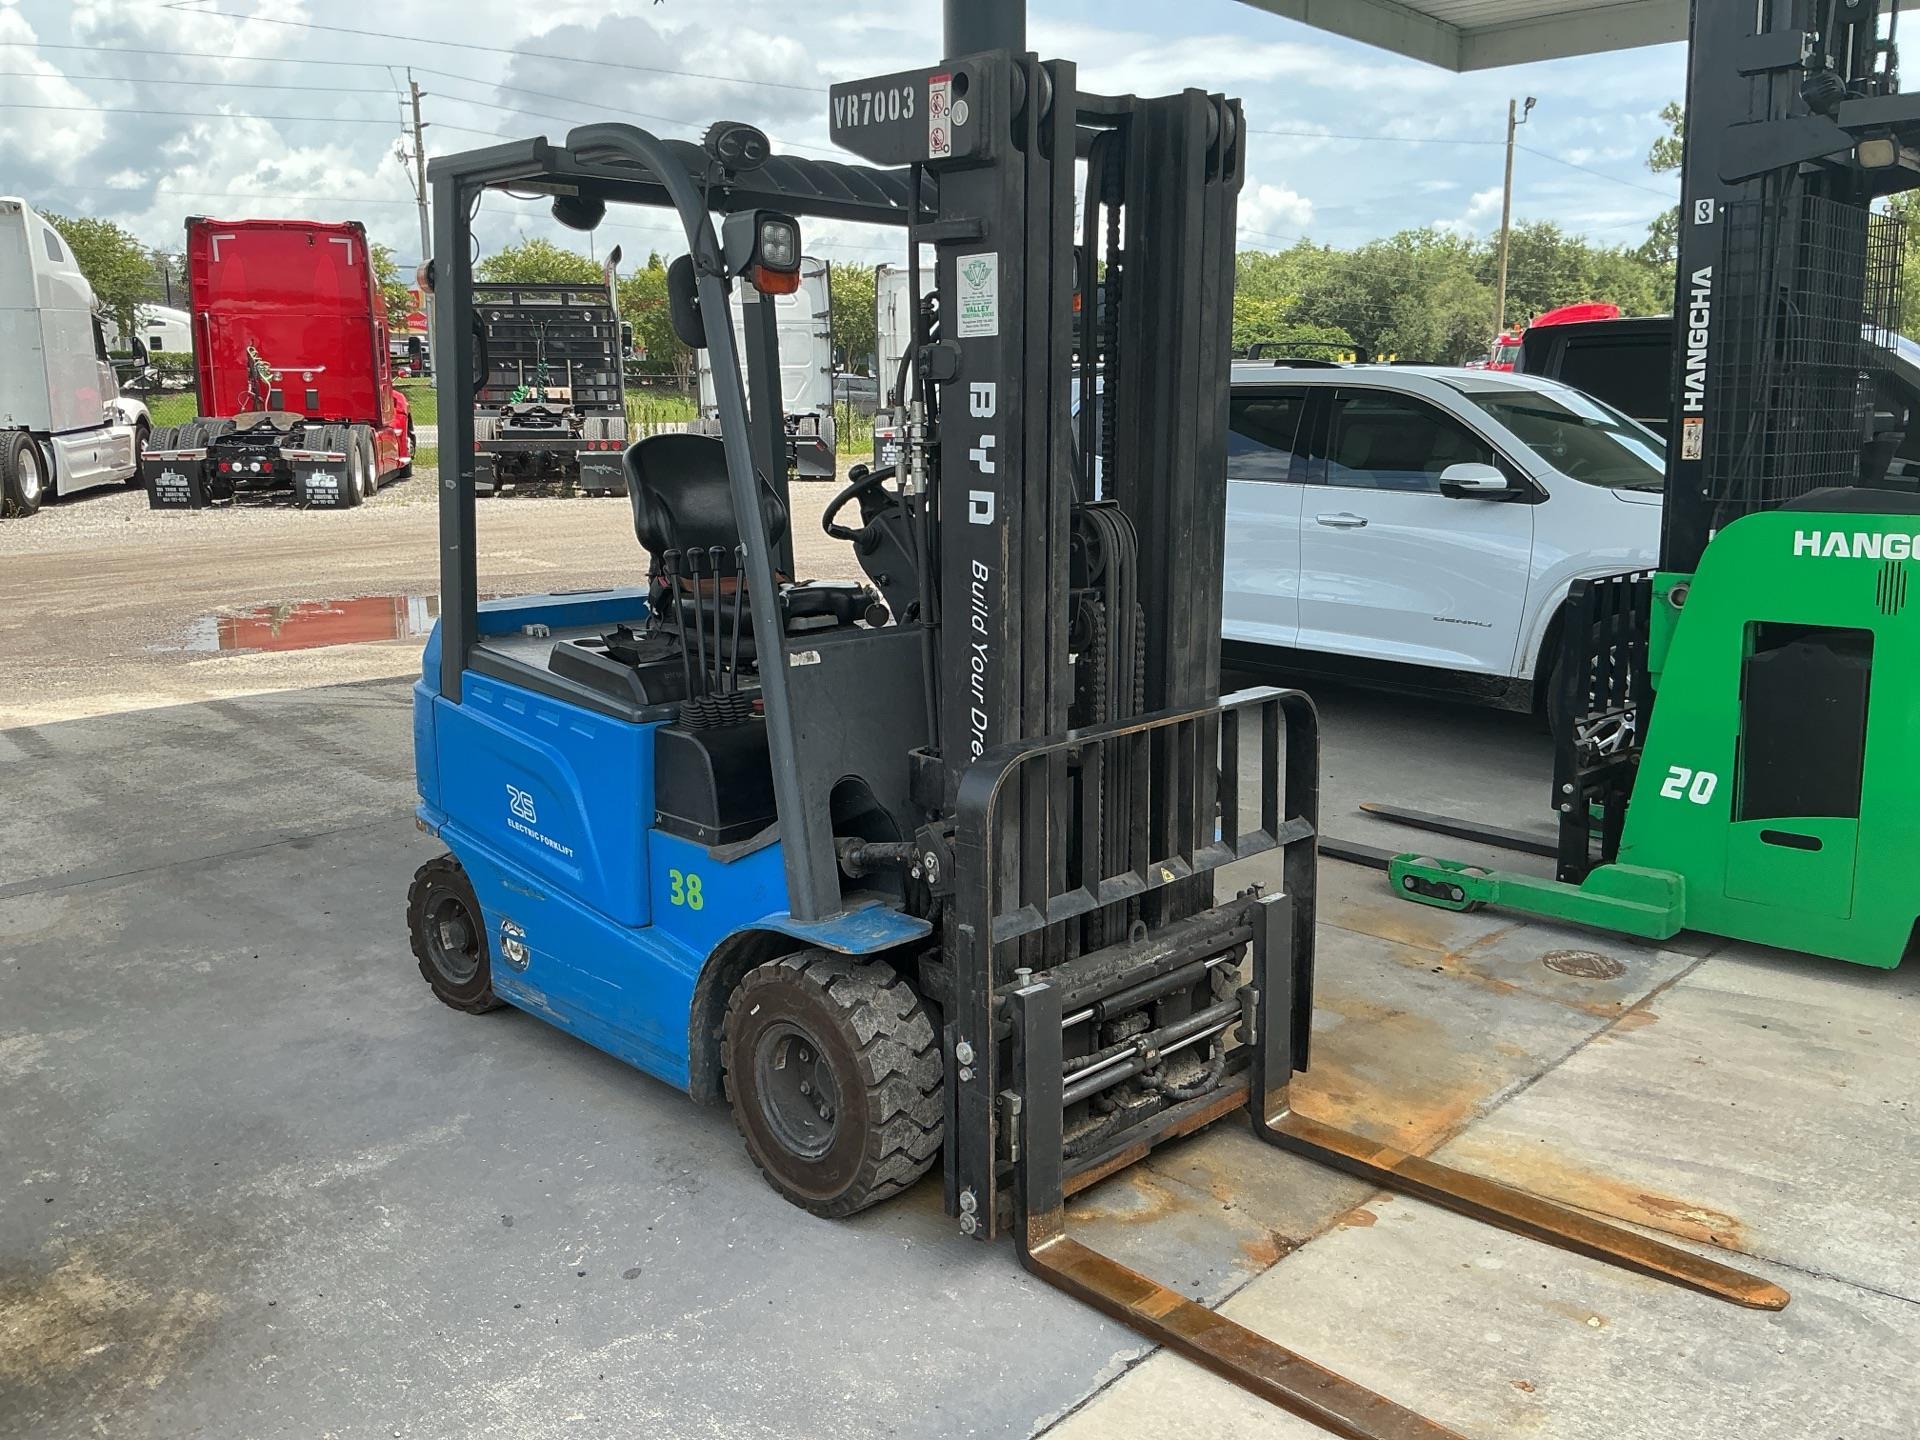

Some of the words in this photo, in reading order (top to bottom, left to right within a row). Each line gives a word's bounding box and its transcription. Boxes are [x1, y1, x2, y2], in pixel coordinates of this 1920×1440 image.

[832, 86, 915, 129] VR7003
[965, 305, 990, 313] VALLEY
[1683, 265, 1712, 412] HANGCHA
[968, 382, 996, 525] BYD
[971, 559, 989, 635] Build
[971, 642, 988, 704] Your
[1659, 765, 1718, 805] 20
[507, 818, 540, 841] ELECTRIC
[539, 834, 574, 858] FORKLIFT
[669, 869, 704, 911] 38
